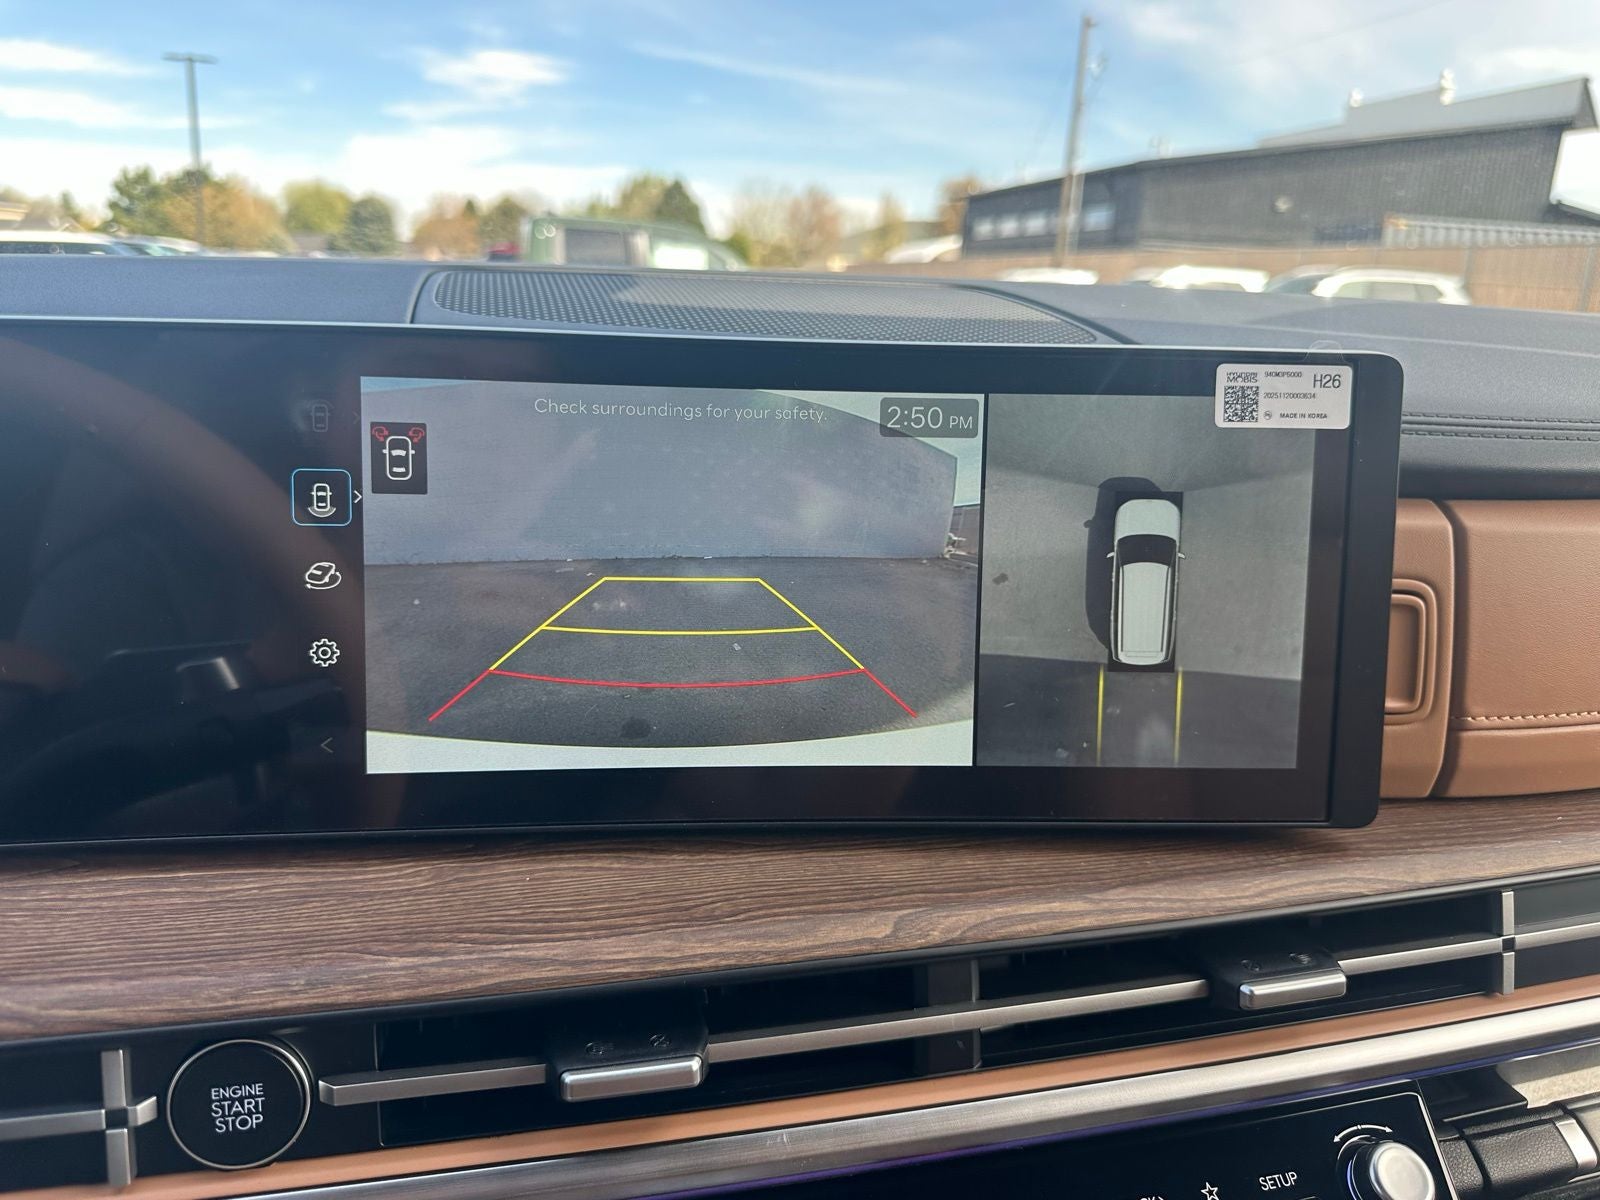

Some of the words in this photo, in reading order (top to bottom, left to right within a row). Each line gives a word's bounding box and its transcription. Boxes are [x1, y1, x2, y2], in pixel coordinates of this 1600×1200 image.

[1313, 374, 1341, 388] H26
[534, 398, 587, 415] Check
[591, 402, 702, 420] surroundings
[706, 404, 730, 418] for
[734, 407, 771, 421] your
[774, 405, 828, 423] safety.
[886, 406, 943, 429] 2:50
[949, 416, 973, 429] PM
[211, 1083, 264, 1100] ENGINE
[211, 1097, 265, 1117] START
[215, 1114, 264, 1133] STOP
[1259, 1171, 1298, 1191] SETUP
